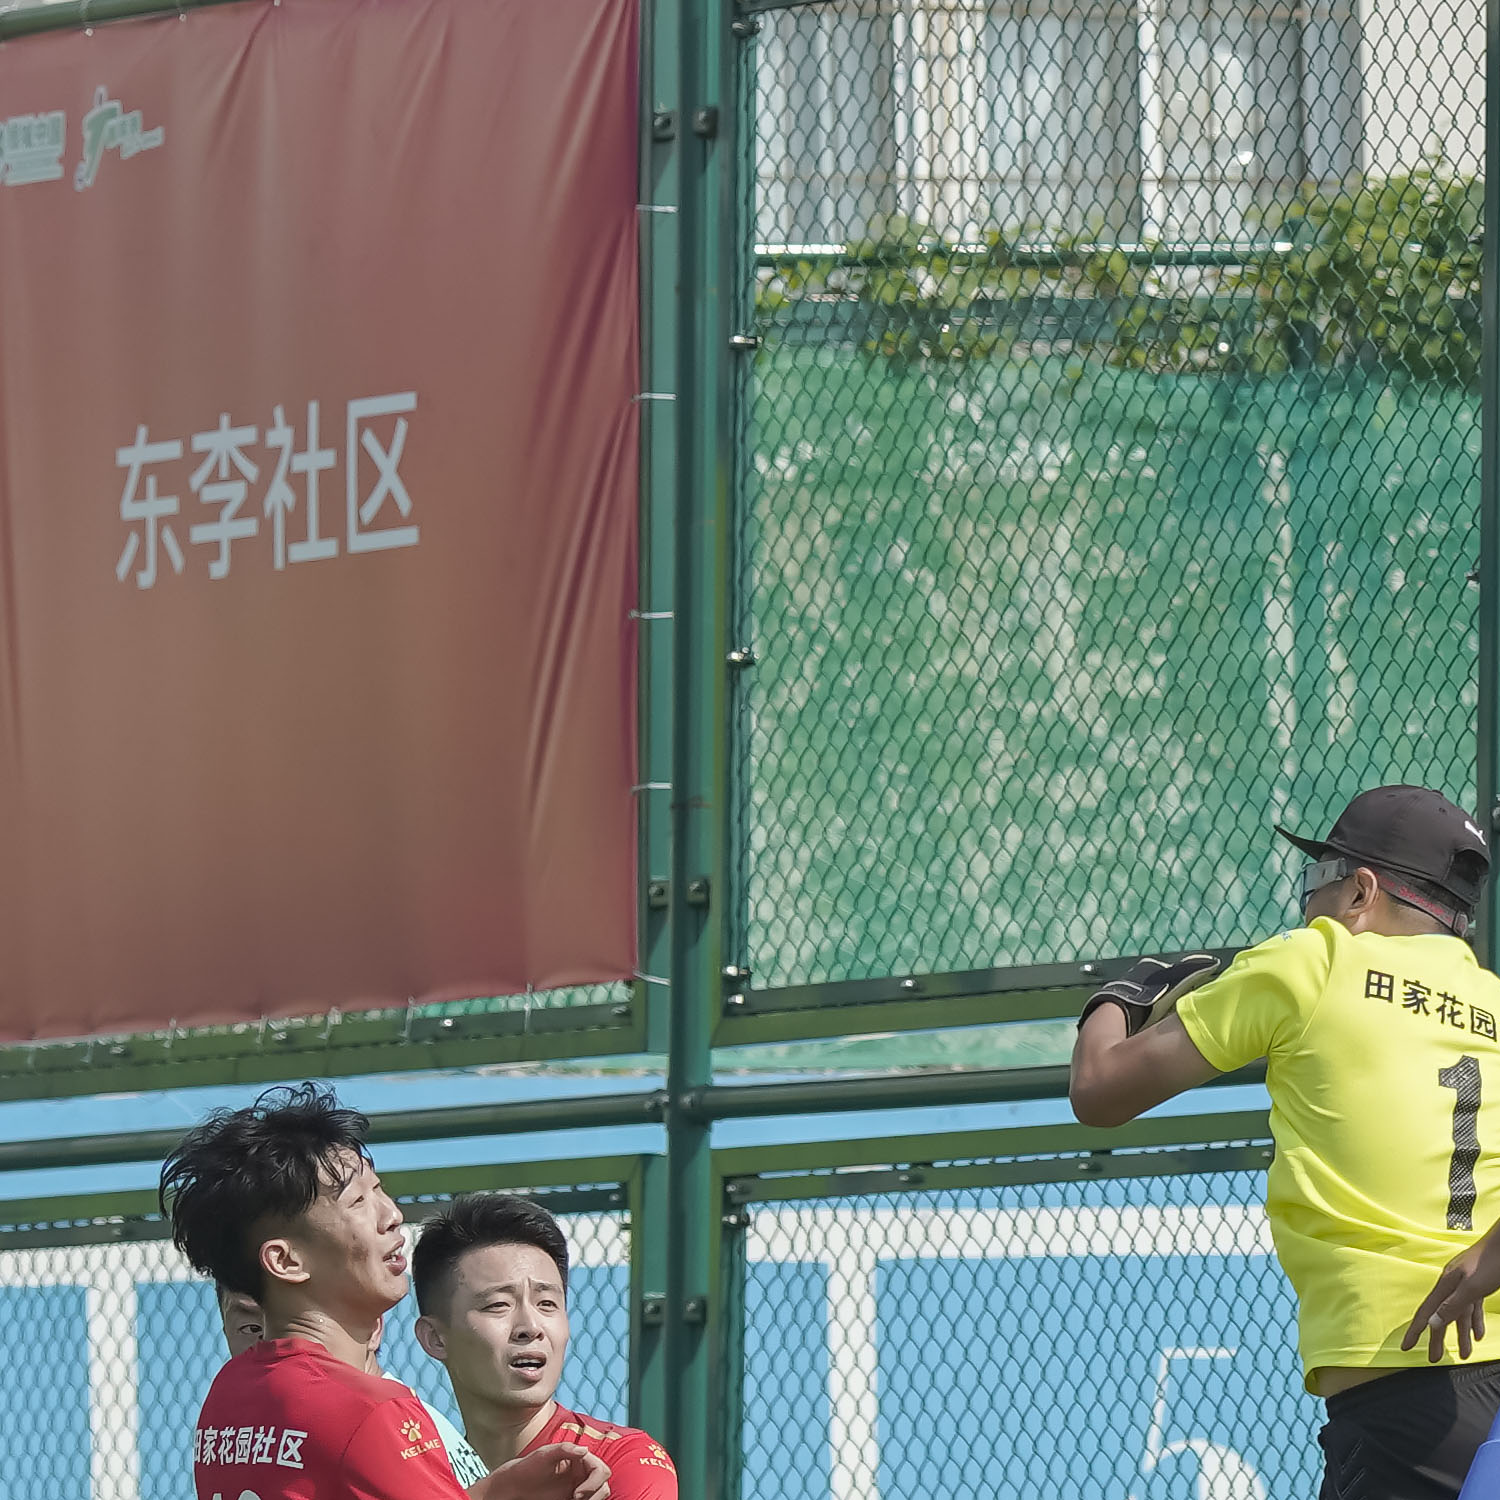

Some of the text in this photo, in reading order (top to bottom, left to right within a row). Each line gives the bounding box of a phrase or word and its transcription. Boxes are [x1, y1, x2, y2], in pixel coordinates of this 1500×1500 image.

[116, 391, 419, 590] 东李社区
[1438, 1054, 1482, 1231] 1
[400, 1438, 441, 1460] KELME
